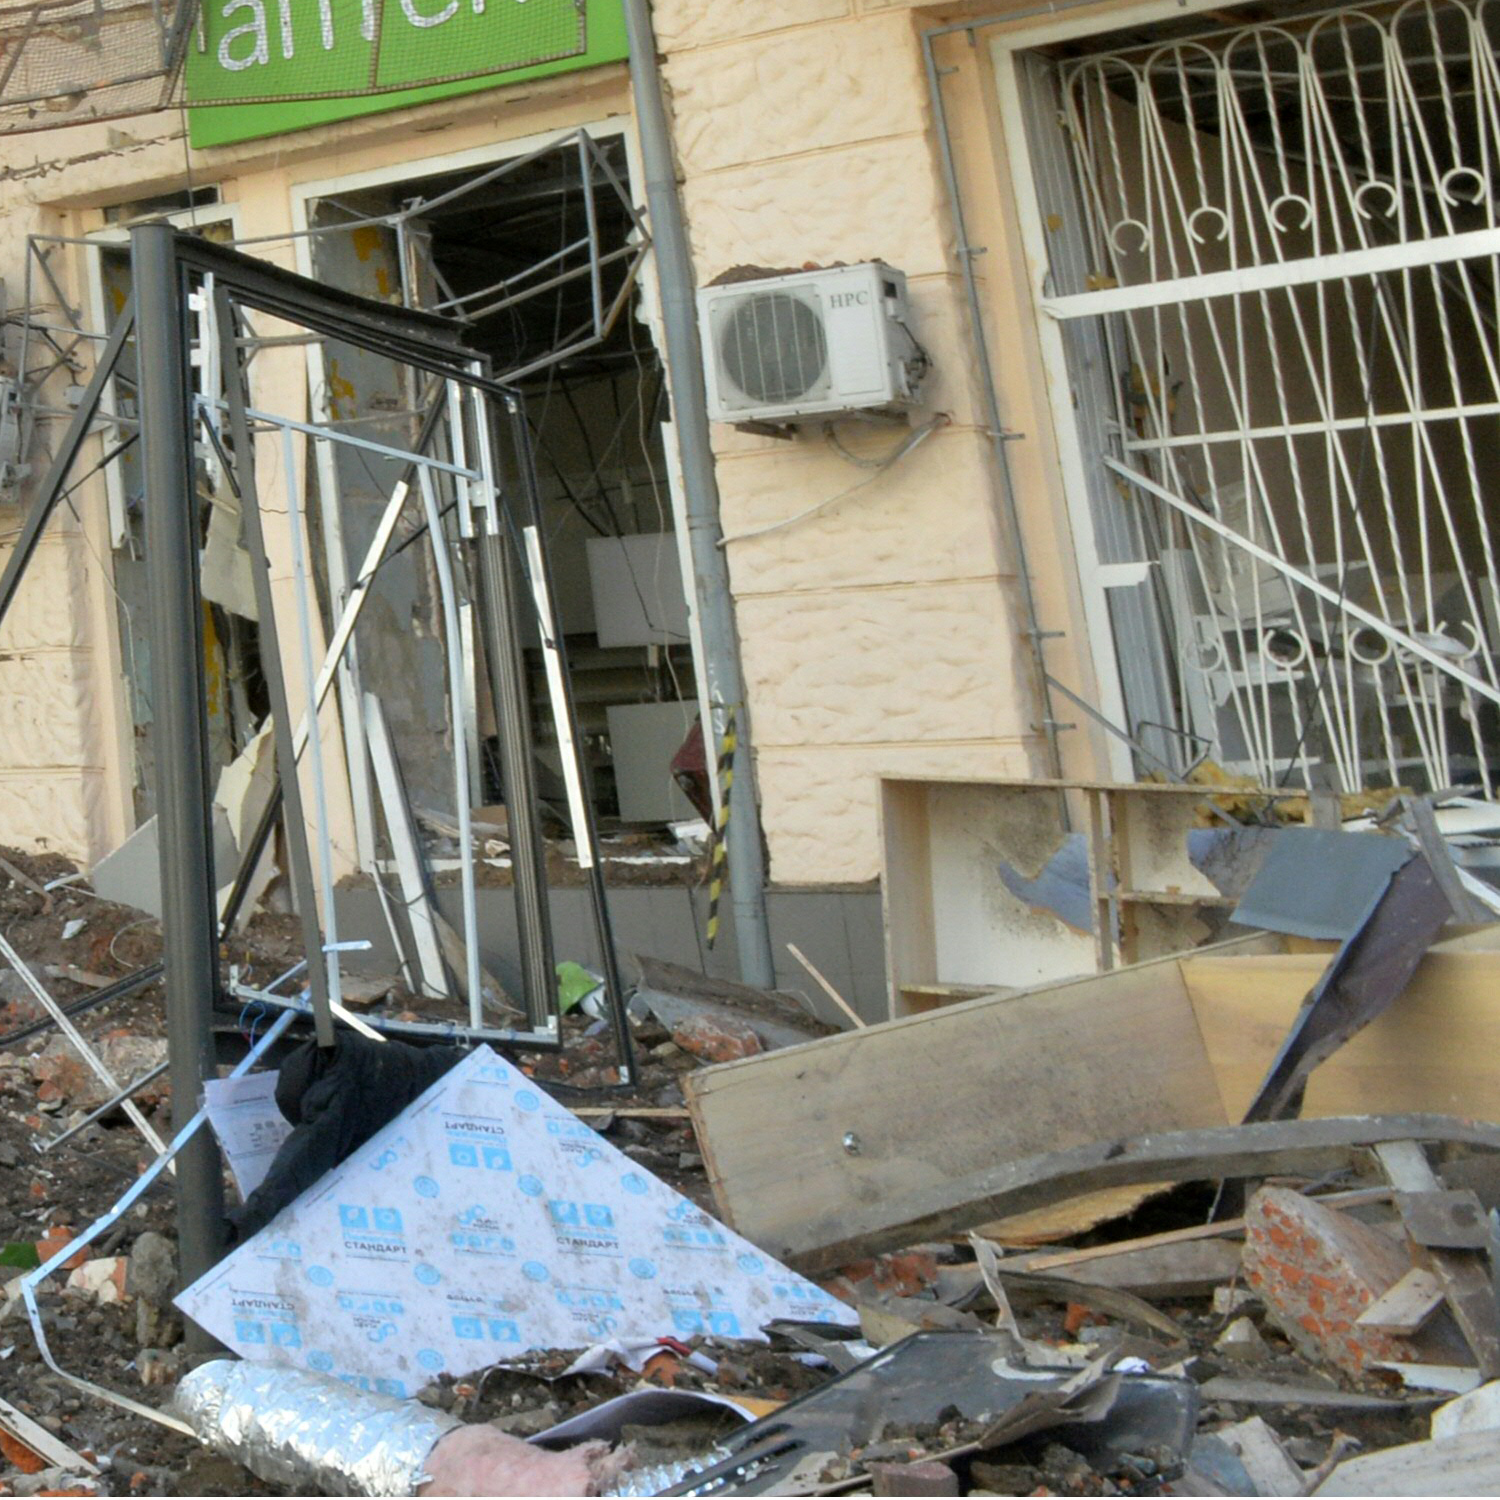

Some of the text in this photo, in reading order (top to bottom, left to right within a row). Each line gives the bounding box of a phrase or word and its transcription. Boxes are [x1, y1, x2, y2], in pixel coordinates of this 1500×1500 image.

[829, 290, 869, 309] HPC
[444, 1121, 505, 1135] СТАНДАРТ
[344, 1241, 407, 1254] СТАНДАРТ
[556, 1236, 619, 1249] СТАНДАРТ
[232, 1298, 295, 1311] СТАНДАРТ
